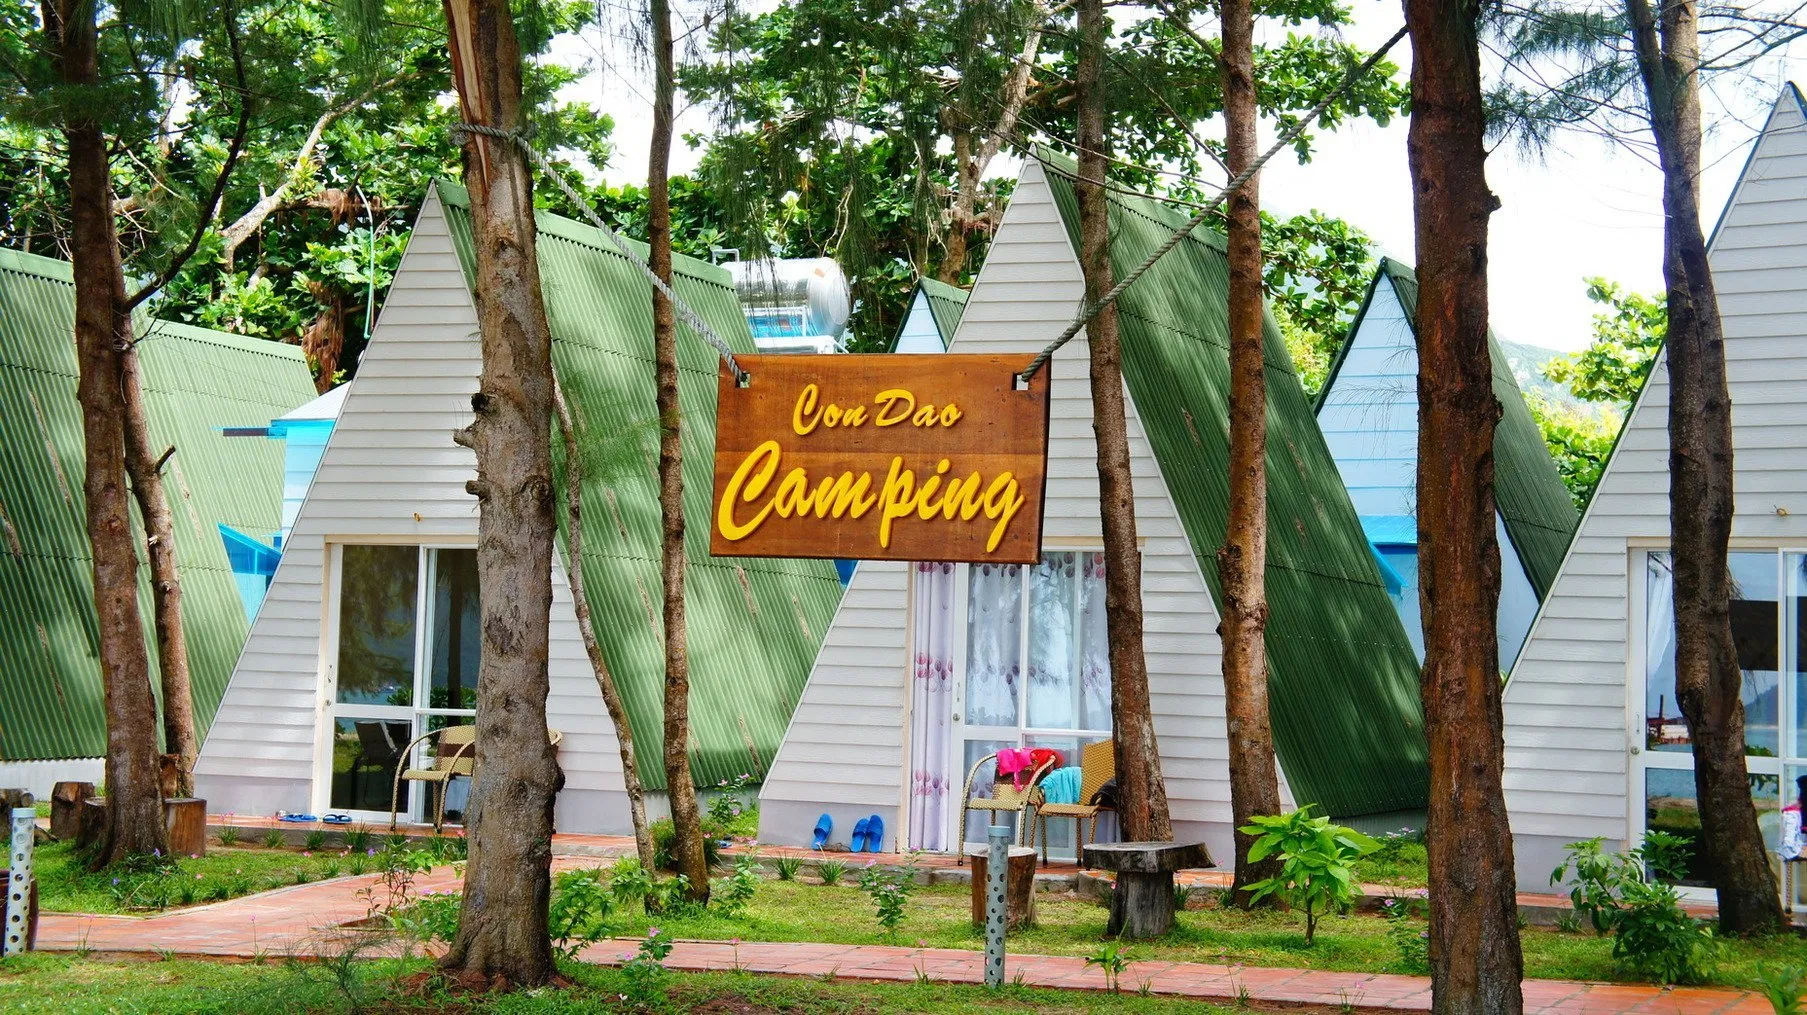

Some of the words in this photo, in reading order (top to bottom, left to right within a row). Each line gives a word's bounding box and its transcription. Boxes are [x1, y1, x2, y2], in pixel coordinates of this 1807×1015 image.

[792, 383, 869, 436] Con
[874, 388, 963, 427] Dao
[717, 439, 1025, 553] Camping
